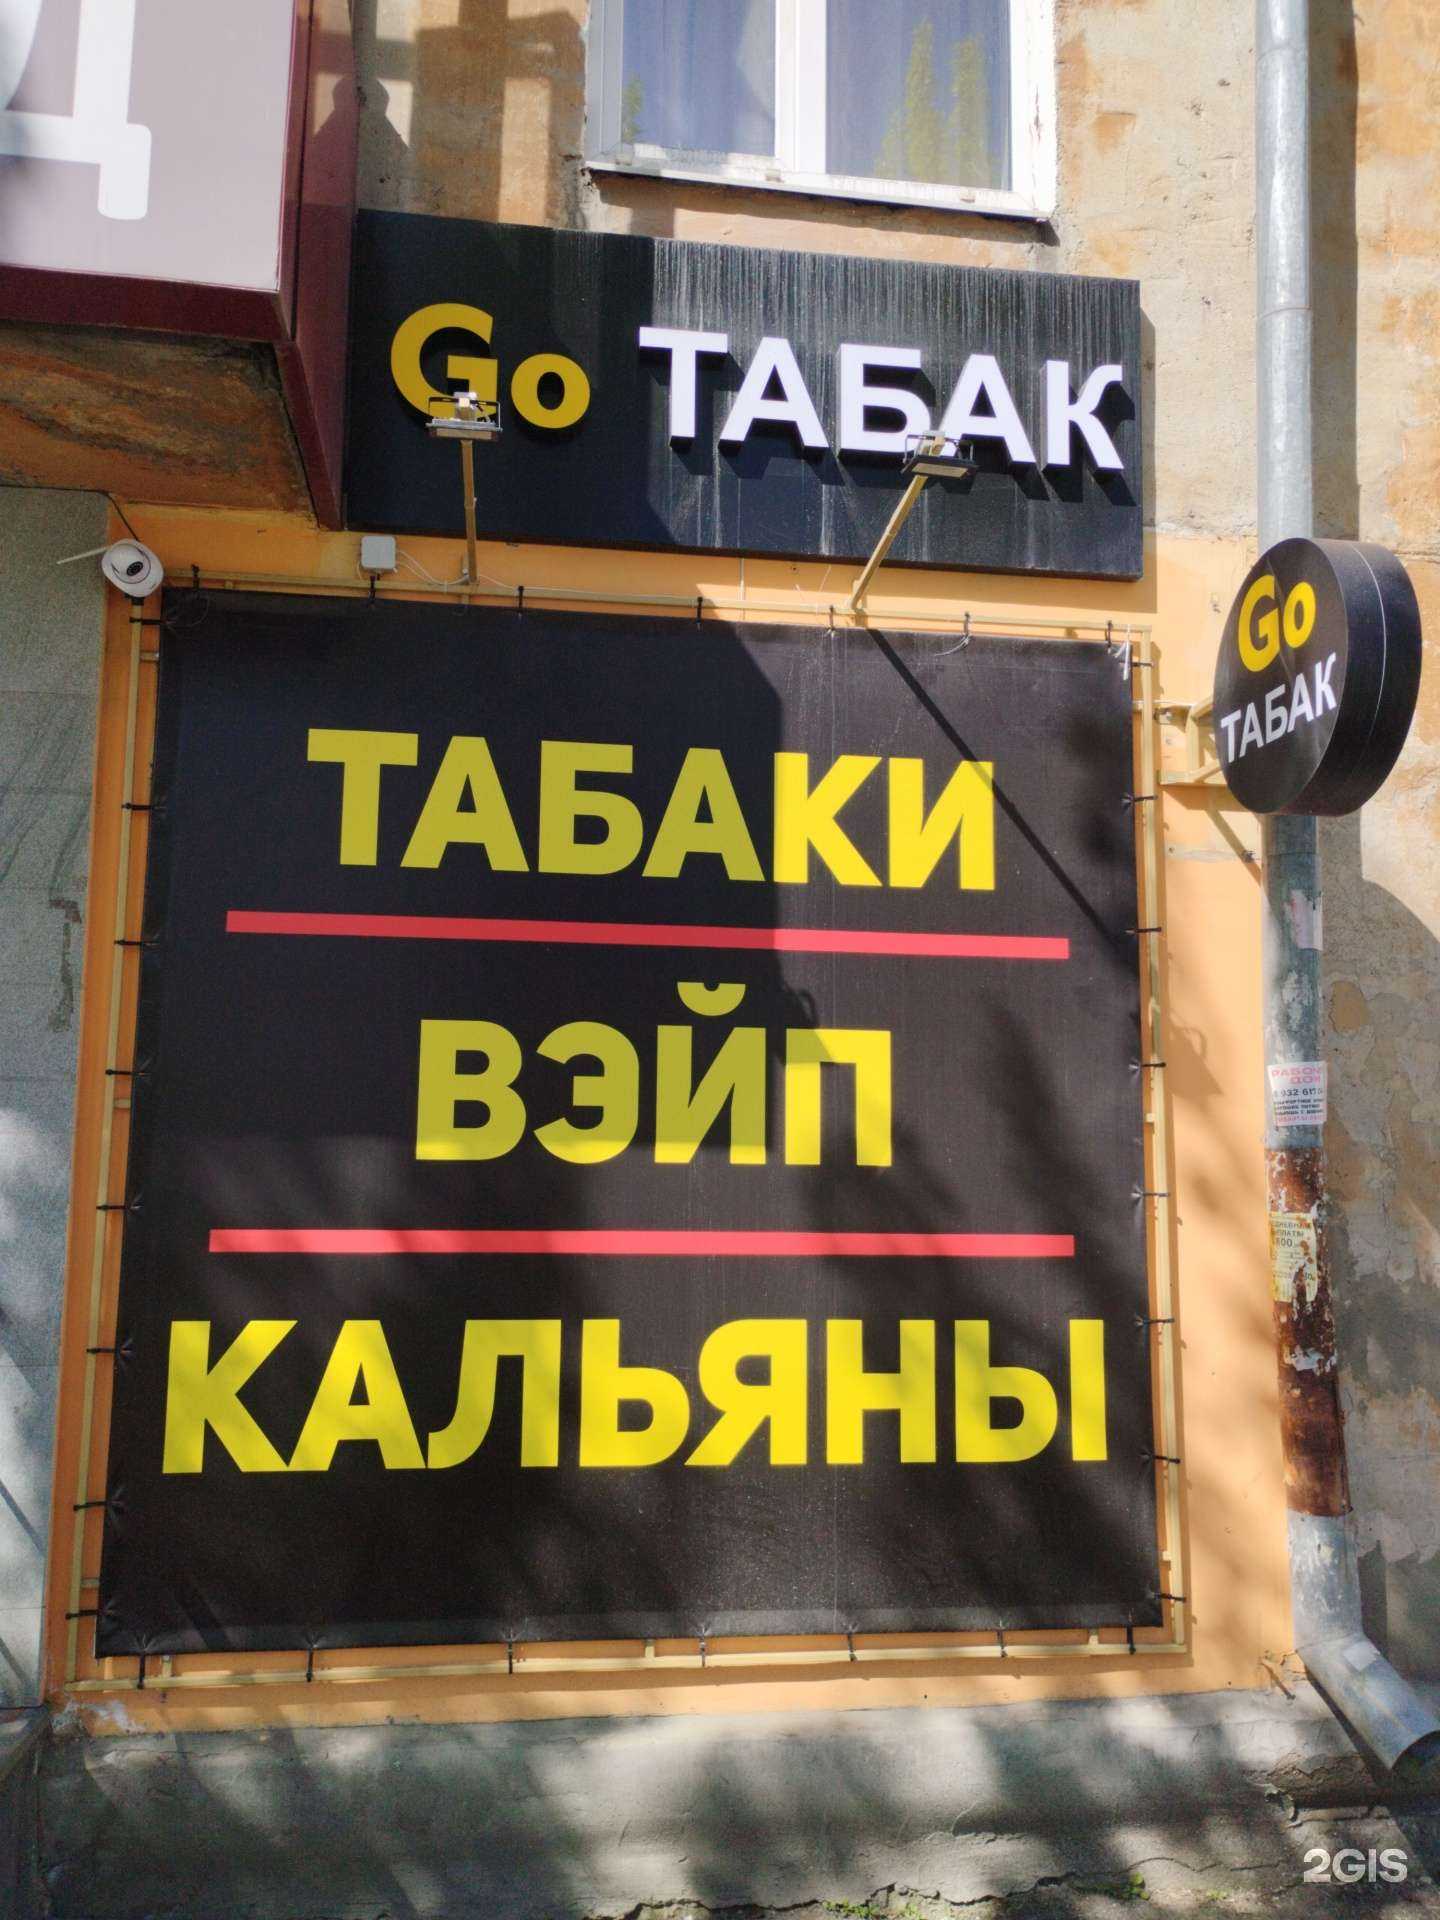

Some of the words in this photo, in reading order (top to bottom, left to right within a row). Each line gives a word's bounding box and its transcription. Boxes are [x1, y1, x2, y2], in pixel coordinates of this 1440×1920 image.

[391, 303, 590, 430] Go
[639, 324, 1124, 470] ТАБАК
[1238, 574, 1317, 673] Go
[1220, 652, 1337, 763] ТАБАК
[308, 729, 996, 891] ТАБАКИ
[415, 982, 893, 1168] ВЭЙП
[163, 1318, 1108, 1473] КАЛЬЯНЫ
